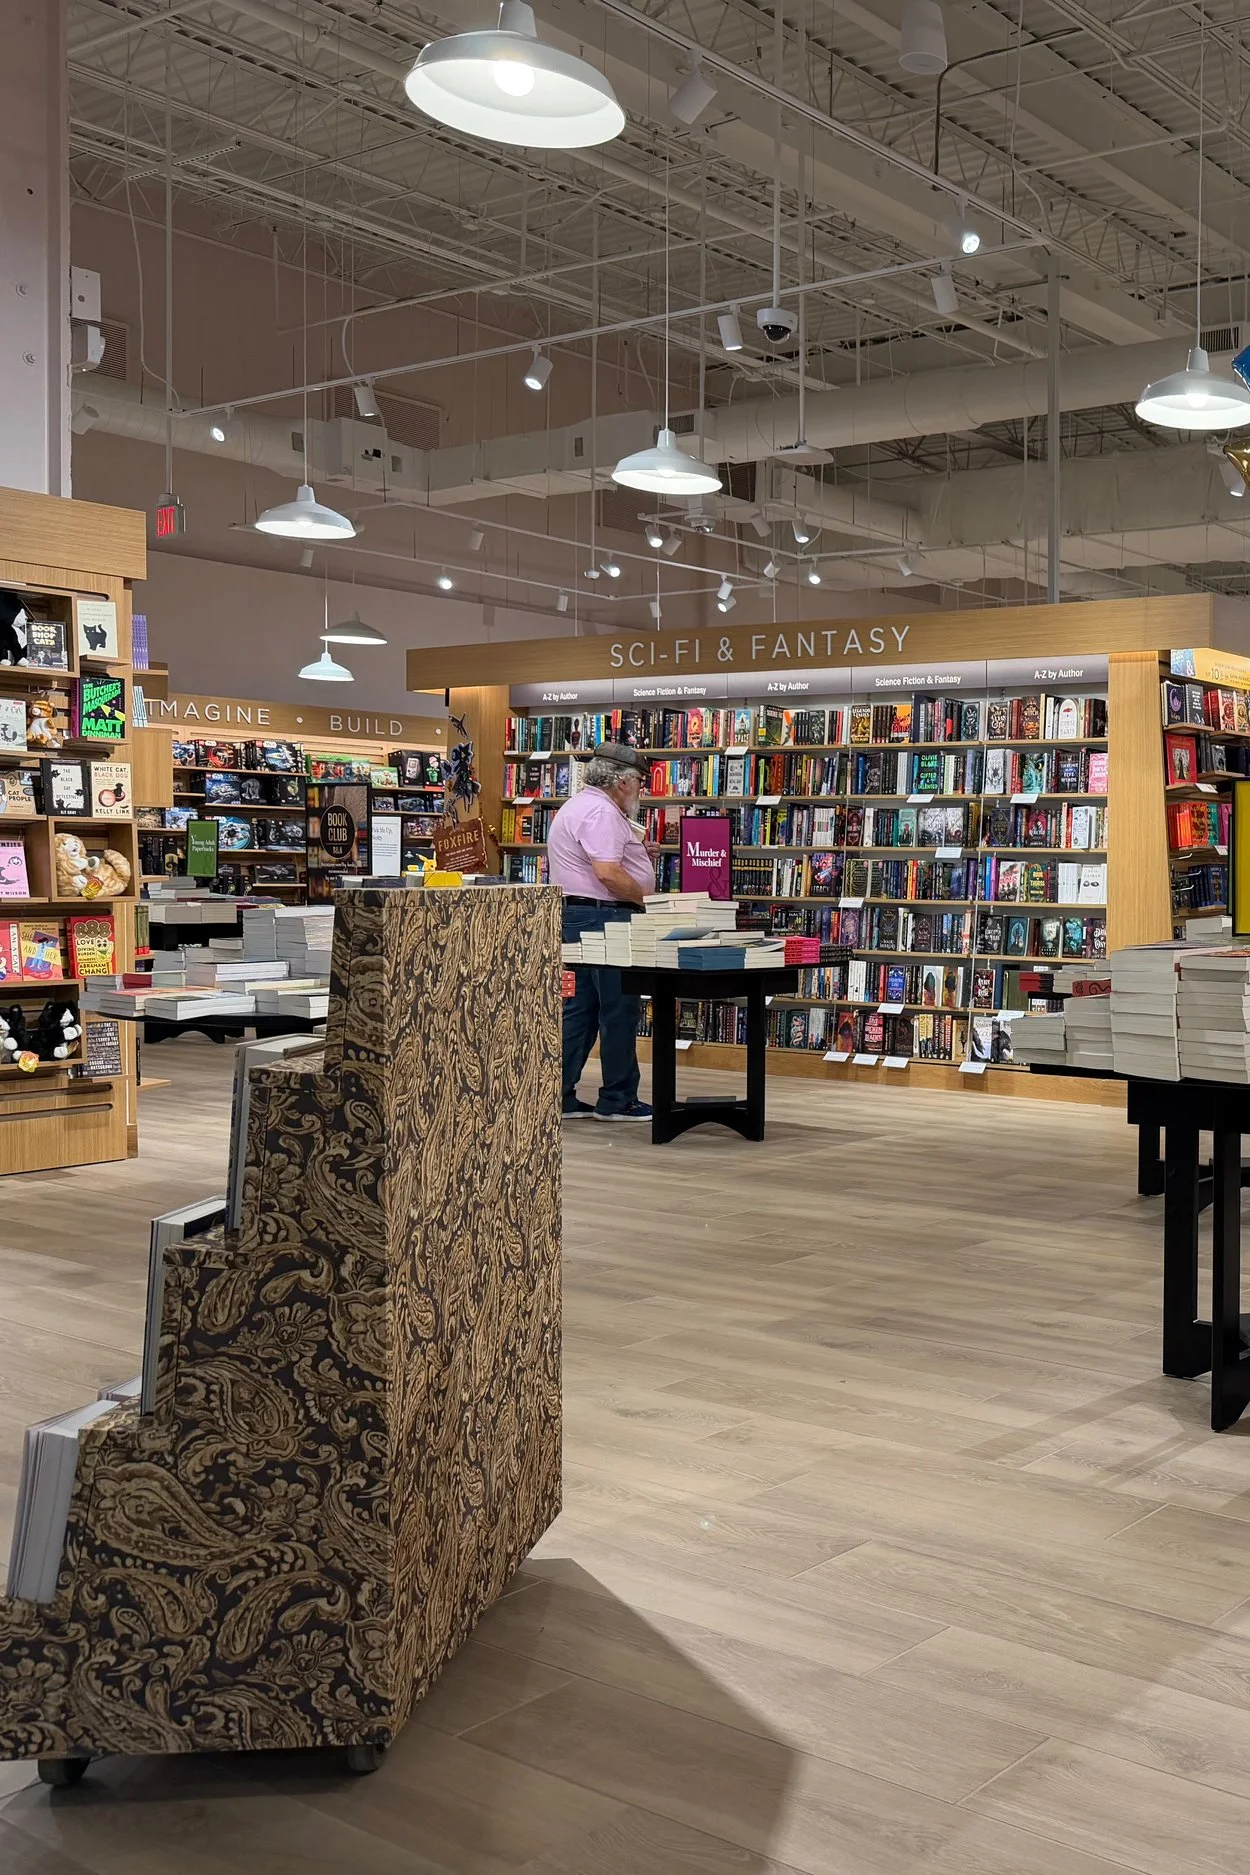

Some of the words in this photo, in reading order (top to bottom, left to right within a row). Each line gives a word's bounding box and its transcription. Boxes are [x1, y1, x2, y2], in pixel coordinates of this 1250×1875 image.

[157, 506, 174, 537] EXIT
[33, 638, 56, 646] CATS
[610, 638, 700, 668] SCI-FI
[717, 637, 734, 662] &
[751, 625, 909, 660] FANTASY
[875, 677, 901, 687] Science
[902, 675, 925, 686] Fiction
[926, 676, 933, 684] &
[934, 674, 962, 687] Fantasy
[1034, 670, 1047, 679] A-Z
[1048, 669, 1057, 681] by
[1058, 668, 1084, 678] Author
[84, 682, 121, 700] BUTCHER'S
[633, 687, 655, 696] Science
[656, 686, 676, 696] Fiction
[677, 687, 683, 695] &
[683, 686, 707, 697] Fantasy
[767, 682, 779, 691] A-Z
[779, 682, 787, 692] by
[788, 682, 809, 690] Author
[83, 689, 121, 715] MASQUERADE
[542, 693, 552, 701] A-Z
[552, 693, 559, 702] by
[560, 692, 578, 701] Author
[81, 718, 123, 731] MATT
[149, 701, 270, 725] IMAGINE
[330, 715, 403, 736] BUILD
[82, 730, 121, 738] DINNIMAN
[327, 812, 348, 826] BOOK
[327, 828, 348, 842] CLUB
[438, 830, 480, 851] FOXFIRE
[686, 841, 719, 857] Murder
[721, 849, 727, 857] &
[692, 858, 722, 867] Mischief
[22, 931, 33, 941] SHE
[74, 920, 112, 939] 888
[23, 944, 37, 955] AND
[44, 949, 58, 960] HER
